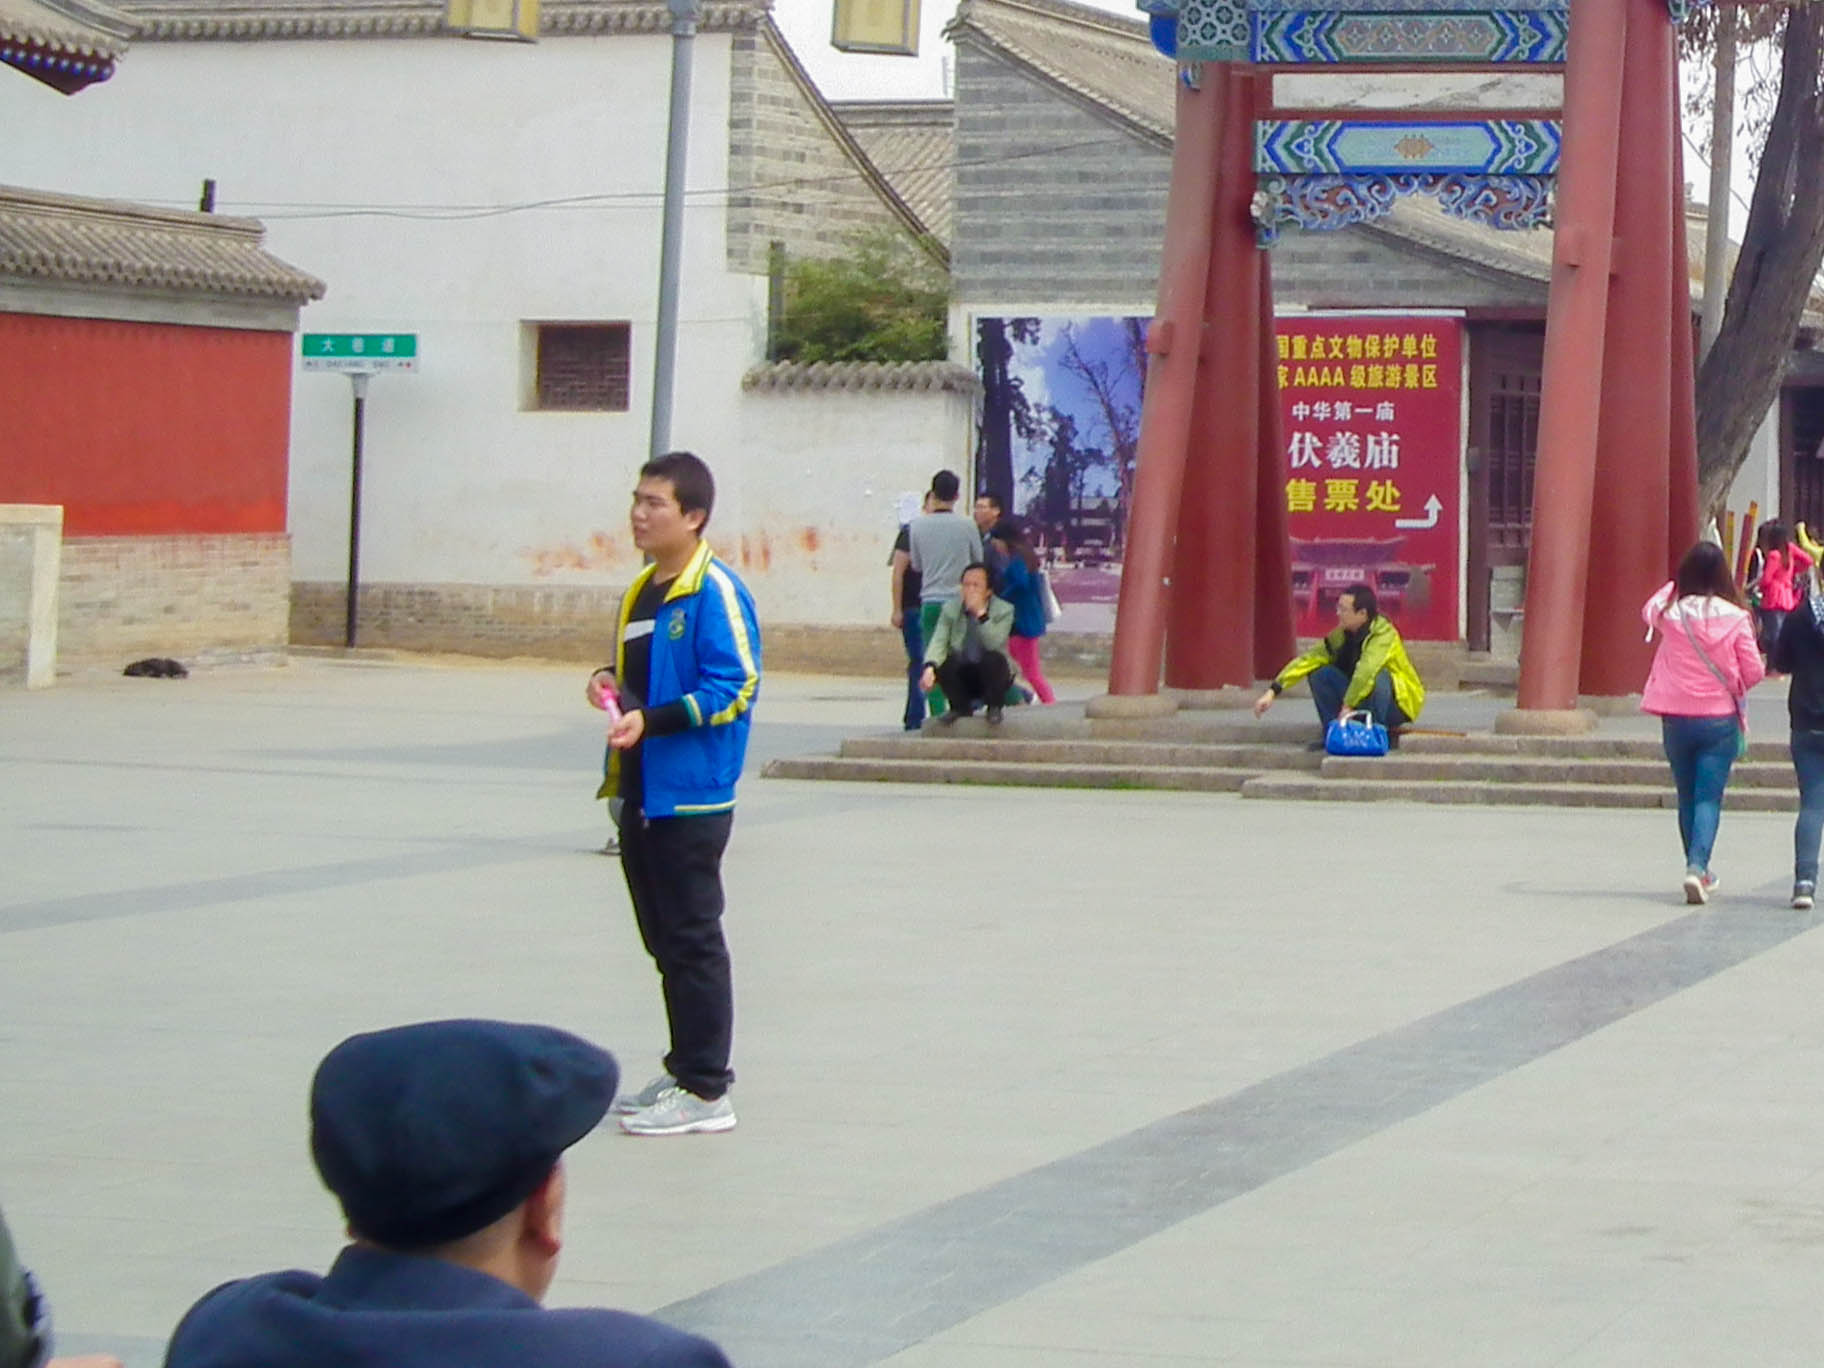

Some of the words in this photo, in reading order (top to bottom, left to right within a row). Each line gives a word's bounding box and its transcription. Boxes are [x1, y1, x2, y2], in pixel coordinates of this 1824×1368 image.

[1294, 366, 1345, 387] AAAA
[1350, 364, 1437, 388] 级旅游景区
[1292, 400, 1395, 421] 中华第一庙
[1288, 431, 1400, 469] 伏羲庙
[1285, 478, 1401, 512] 售票处
